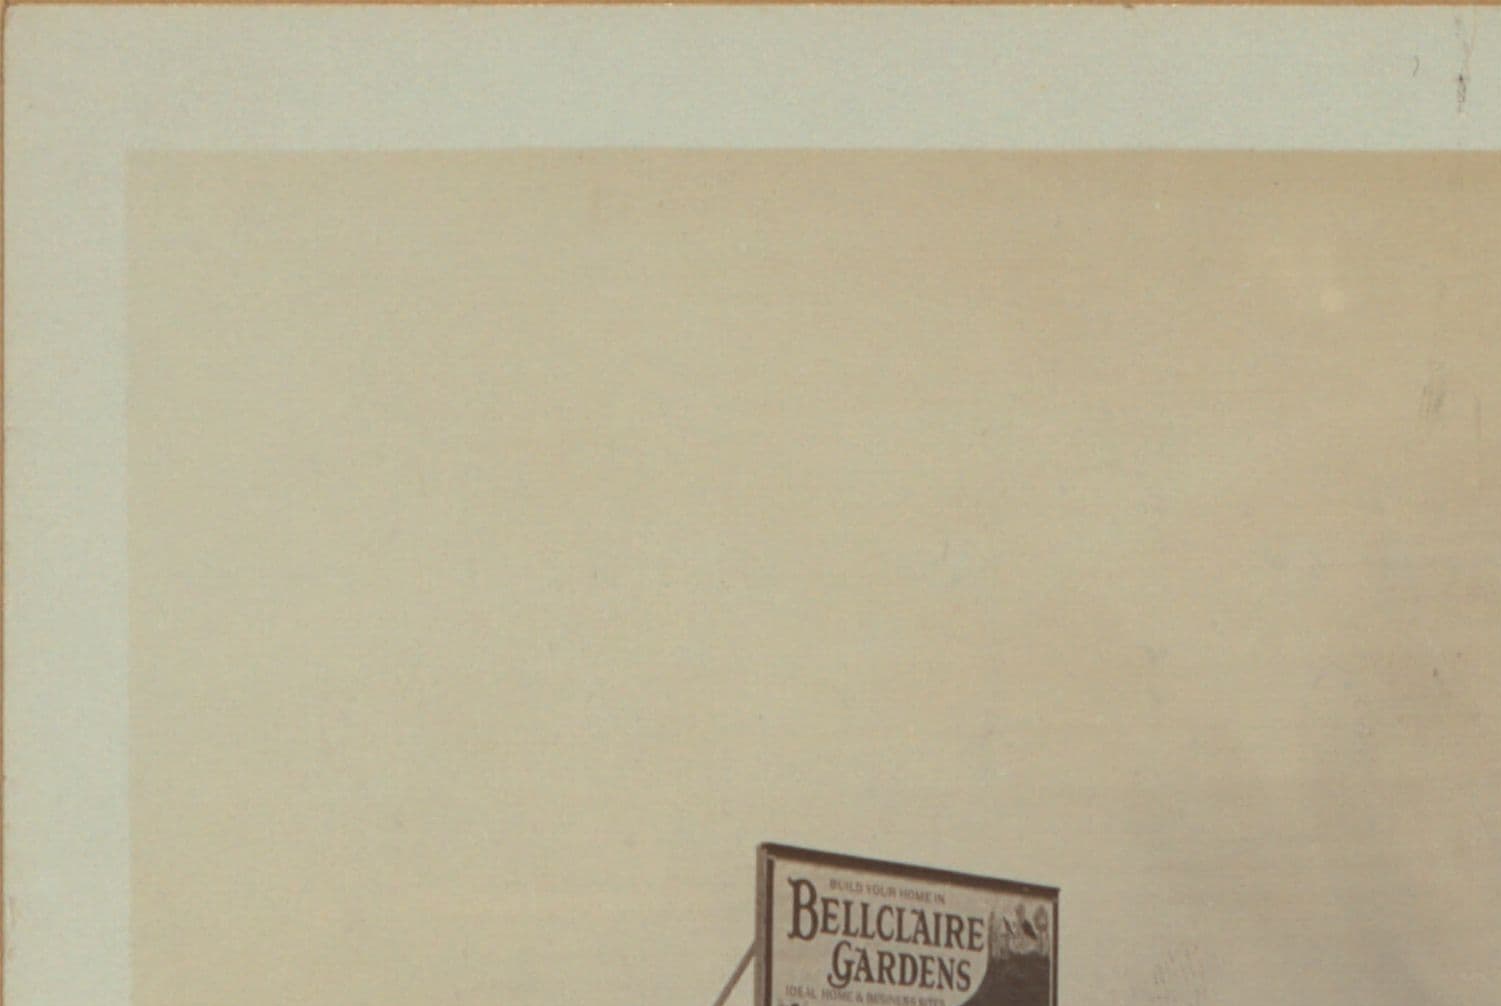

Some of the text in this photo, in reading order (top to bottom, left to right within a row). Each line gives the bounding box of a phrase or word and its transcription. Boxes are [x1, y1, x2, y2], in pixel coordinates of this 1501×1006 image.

[866, 884, 896, 898] YOUR
[934, 892, 946, 904] IN
[787, 876, 985, 952] BELLCLAIRE
[827, 940, 972, 993] GARDENS
[785, 984, 817, 1000] IDEAL
[821, 988, 853, 1003] HOME
